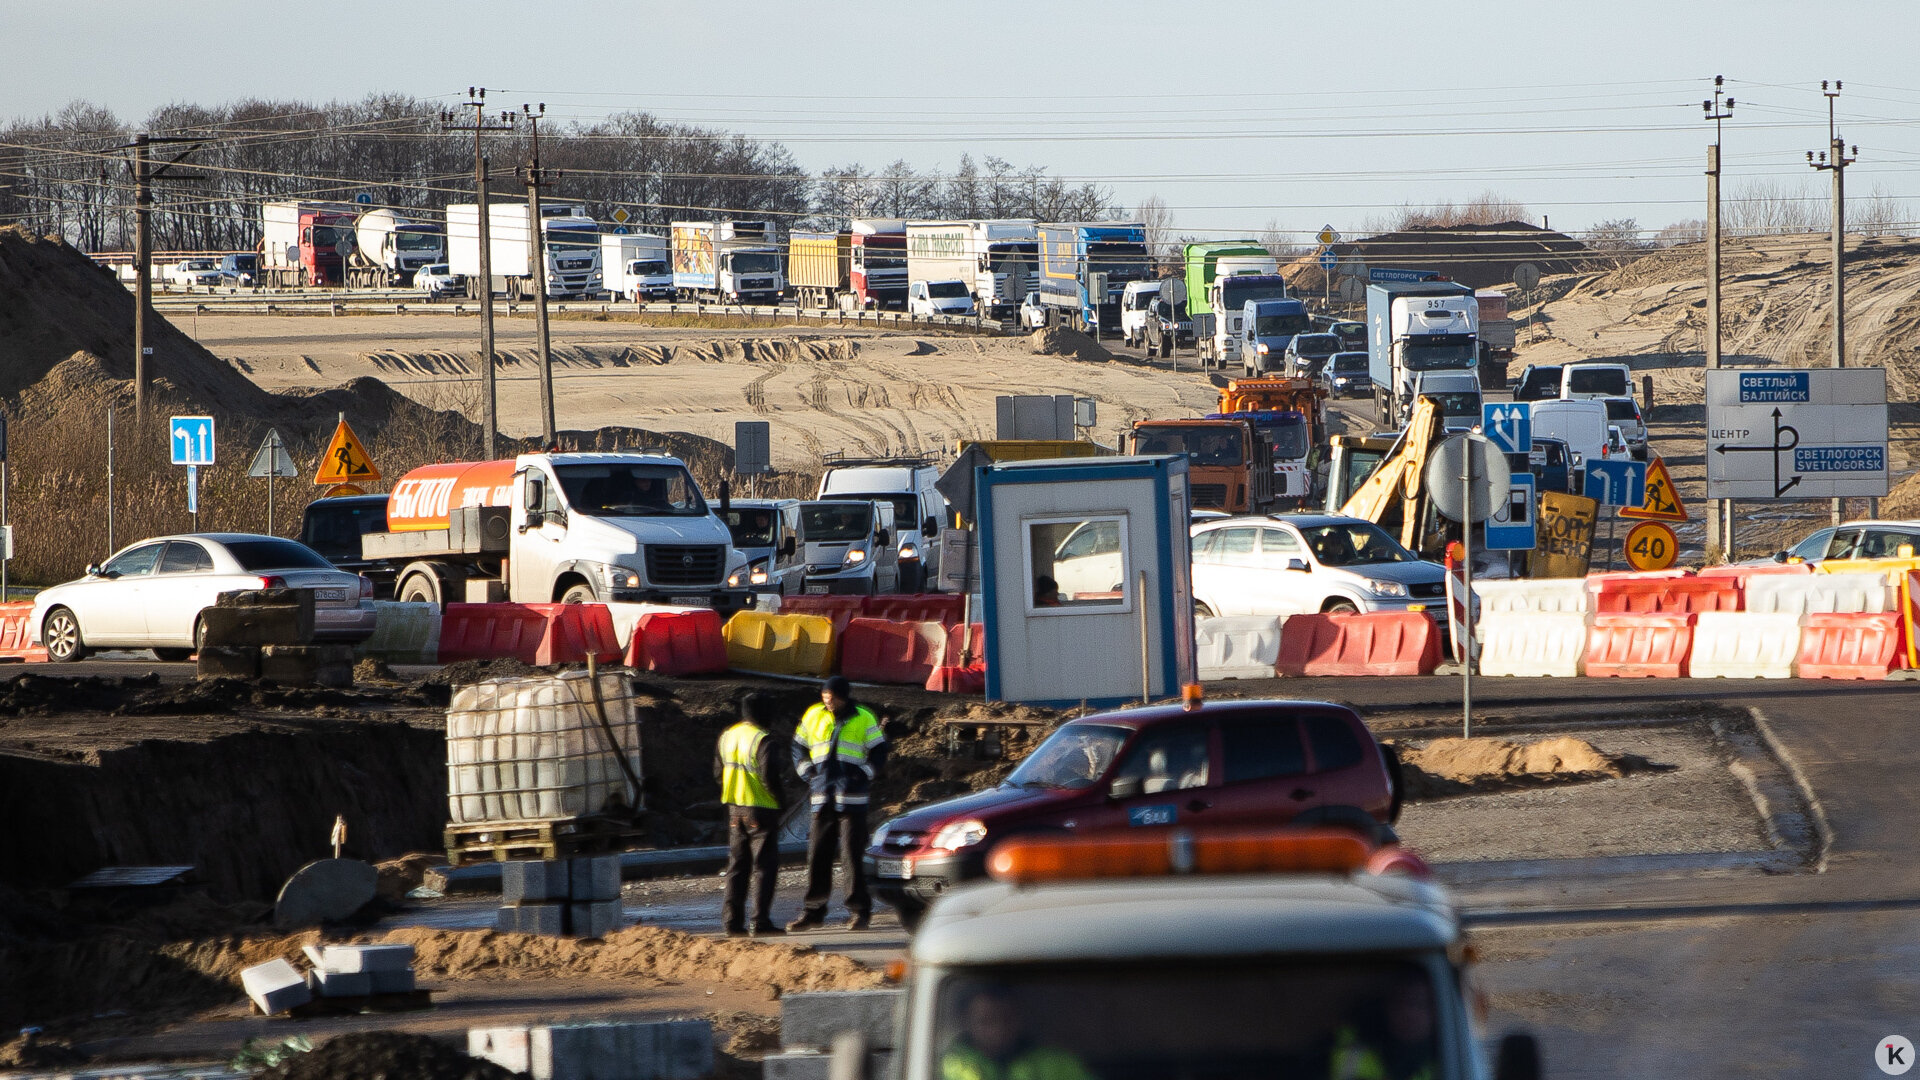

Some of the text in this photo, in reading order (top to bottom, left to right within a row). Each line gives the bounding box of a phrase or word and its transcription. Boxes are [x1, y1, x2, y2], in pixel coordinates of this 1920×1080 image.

[1372, 271, 1418, 280] СВЕТЛОГОРСК
[1427, 300, 1446, 308] 957
[1742, 375, 1797, 387] СВЕТЛЫЙ
[1742, 389, 1806, 400] БАЛТИЙСК
[1711, 430, 1750, 439] ЦЕНТР
[1796, 450, 1881, 459] СВЕТЛОГОРСК
[1797, 460, 1881, 470] SVETLOGORSK
[390, 477, 458, 518] 567070
[1633, 537, 1665, 559] 40
